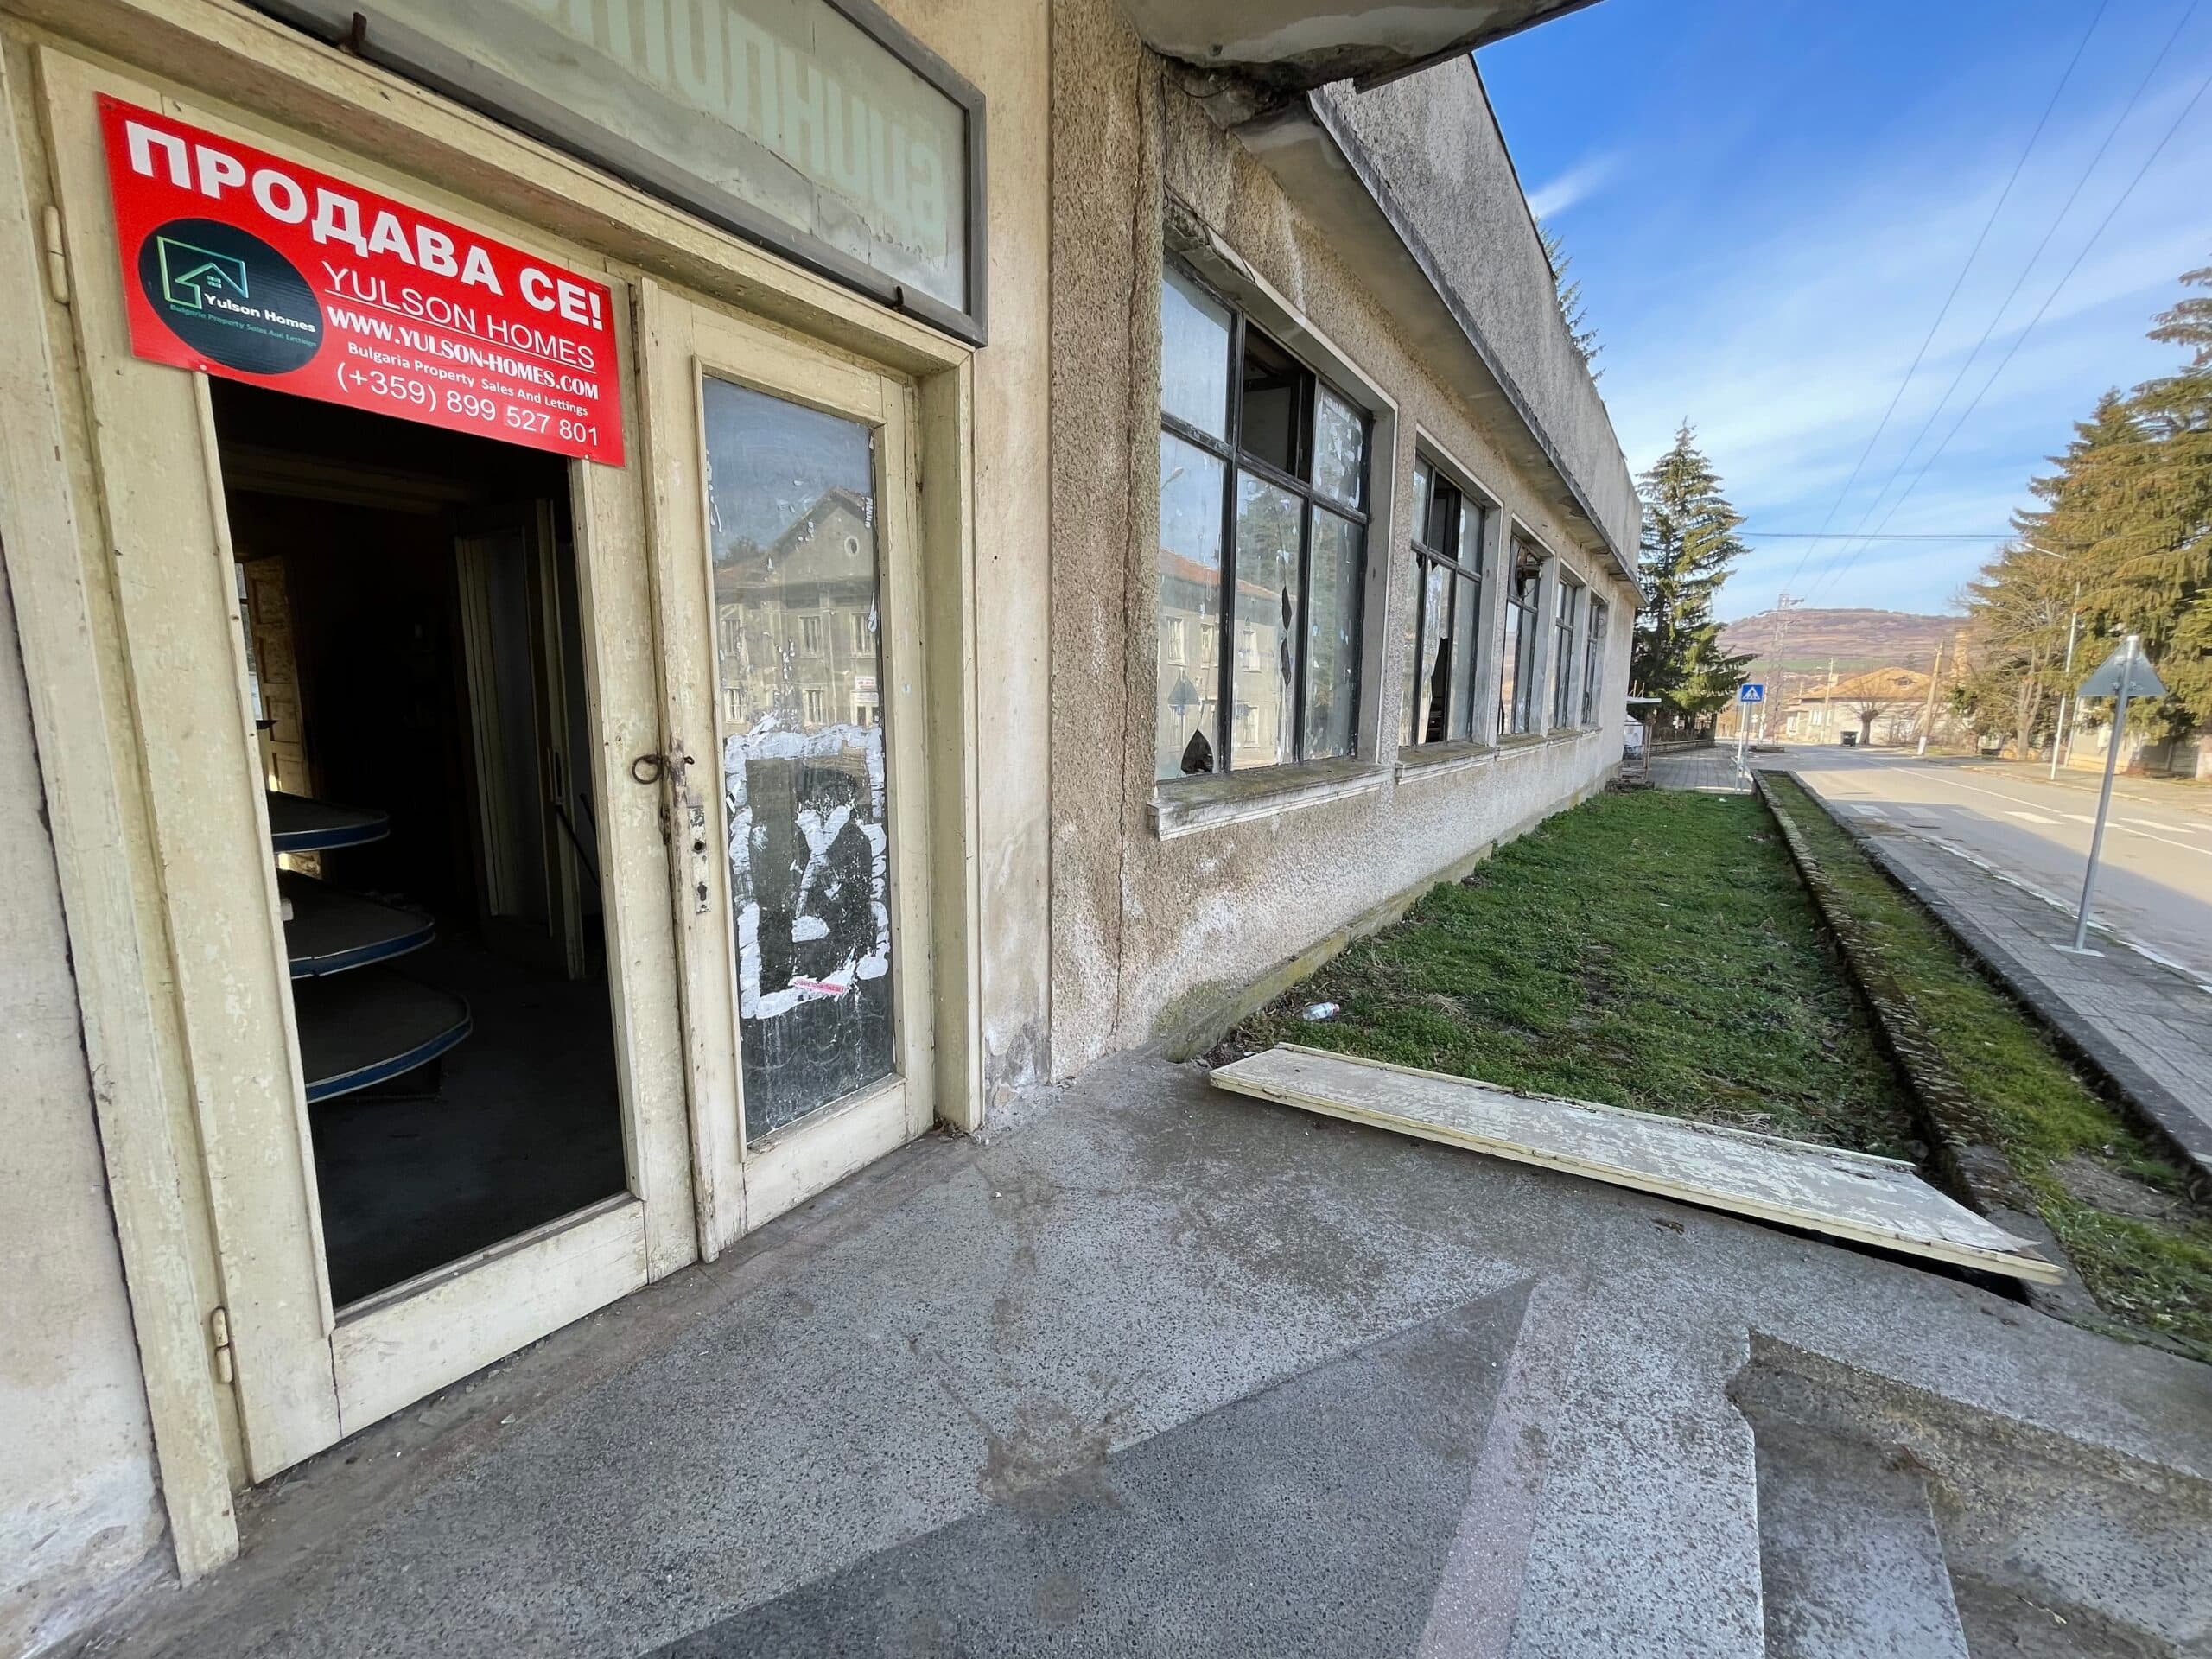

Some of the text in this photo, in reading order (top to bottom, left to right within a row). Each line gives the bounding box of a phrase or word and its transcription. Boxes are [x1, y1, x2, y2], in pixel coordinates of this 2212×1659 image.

[536, 0, 946, 244] илница
[125, 120, 603, 331] ПРОДАВА СЕ!
[204, 293, 316, 333] Yulson Homes
[207, 314, 245, 330] Property
[246, 323, 268, 335] Sales
[268, 329, 284, 340] And
[321, 260, 594, 370] YULSON HOMES
[327, 306, 599, 400] WWW.YULSON-HOMES.COM
[337, 362, 598, 447] (+359) 899 527 801
[348, 341, 588, 417] Bulgaria Property Sales And Lettings
